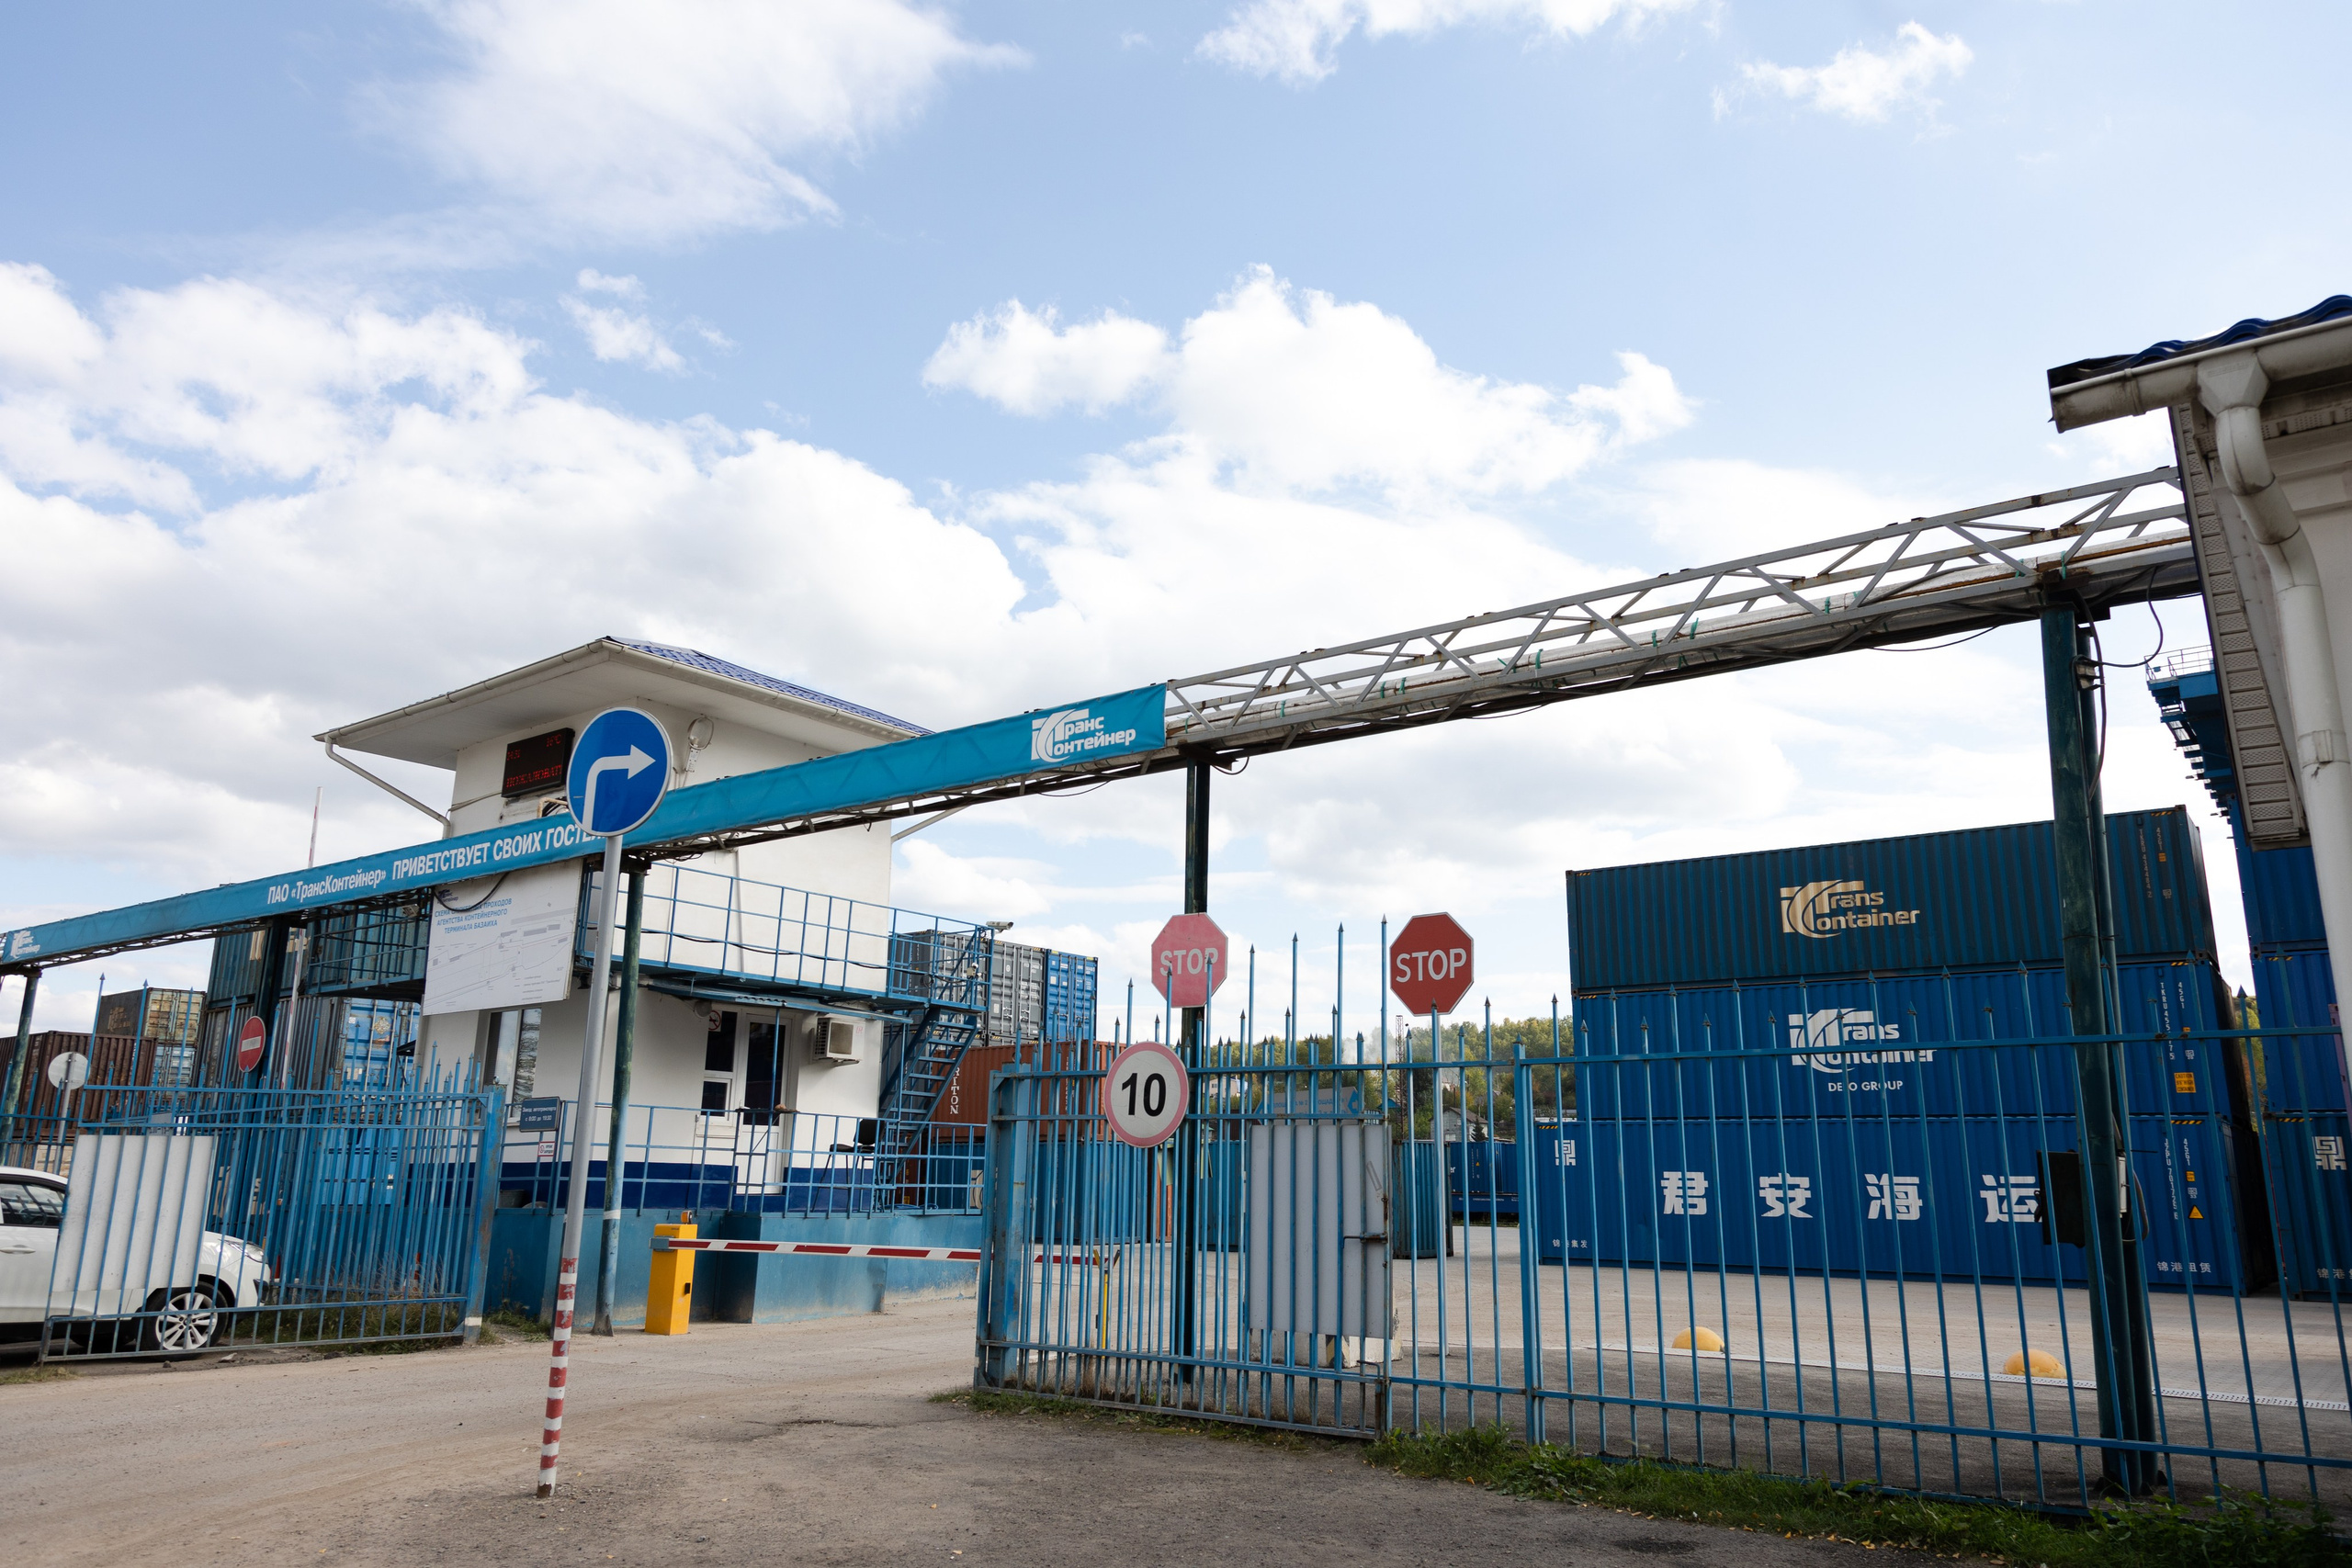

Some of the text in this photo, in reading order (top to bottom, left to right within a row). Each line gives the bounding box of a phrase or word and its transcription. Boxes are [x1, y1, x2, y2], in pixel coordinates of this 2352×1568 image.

[267, 883, 289, 905] ПАО
[291, 868, 387, 903] «ТрансКонтейнер»
[392, 842, 491, 880] ПРИВЕТСТВУЕТ
[492, 830, 543, 861] СВОИХ
[435, 908, 450, 918] СХЕМА
[483, 897, 513, 909] ПРОХОДОВ
[436, 916, 464, 927] АГЕНТСТВА
[464, 908, 508, 922] КОНТЕЙНЕРНОГО
[445, 922, 473, 934] ТЕРМИНАЛА
[1159, 947, 1219, 976] STOP
[1396, 947, 1467, 983] STOP
[949, 1057, 961, 1114] RITON
[1121, 1072, 1167, 1118] 10
[1828, 1082, 1858, 1092] DEO
[1660, 1170, 2042, 1223] 君安海运
[1553, 1238, 1588, 1248] 锦集发
